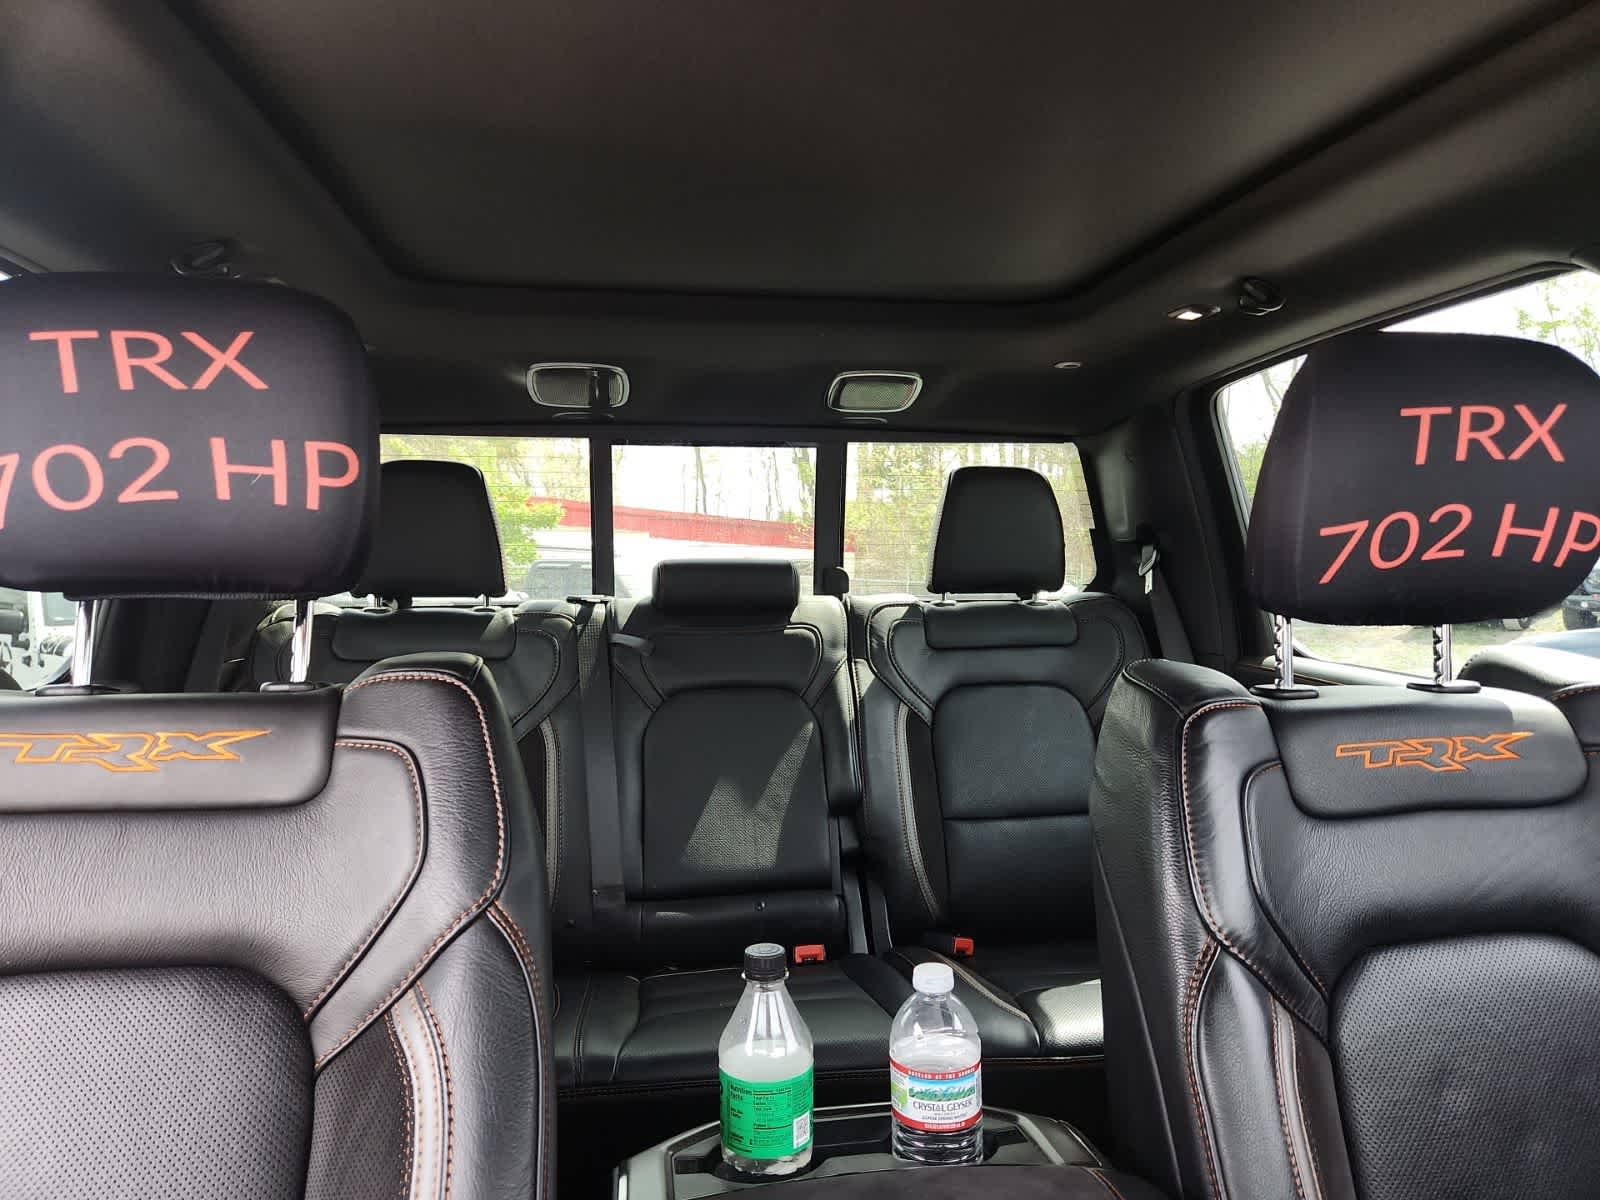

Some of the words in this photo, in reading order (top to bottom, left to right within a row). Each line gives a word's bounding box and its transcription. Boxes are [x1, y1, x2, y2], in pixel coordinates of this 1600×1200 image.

[29, 330, 269, 393] TRX
[1401, 403, 1567, 465] TRX
[209, 437, 360, 511] HP
[1319, 503, 1472, 584] 702
[1492, 503, 1600, 568] HP
[0, 728, 272, 772] TRX
[1335, 730, 1534, 773] TRX
[912, 1100, 946, 1112] CRYSTAL
[946, 1099, 973, 1112] GEYSER
